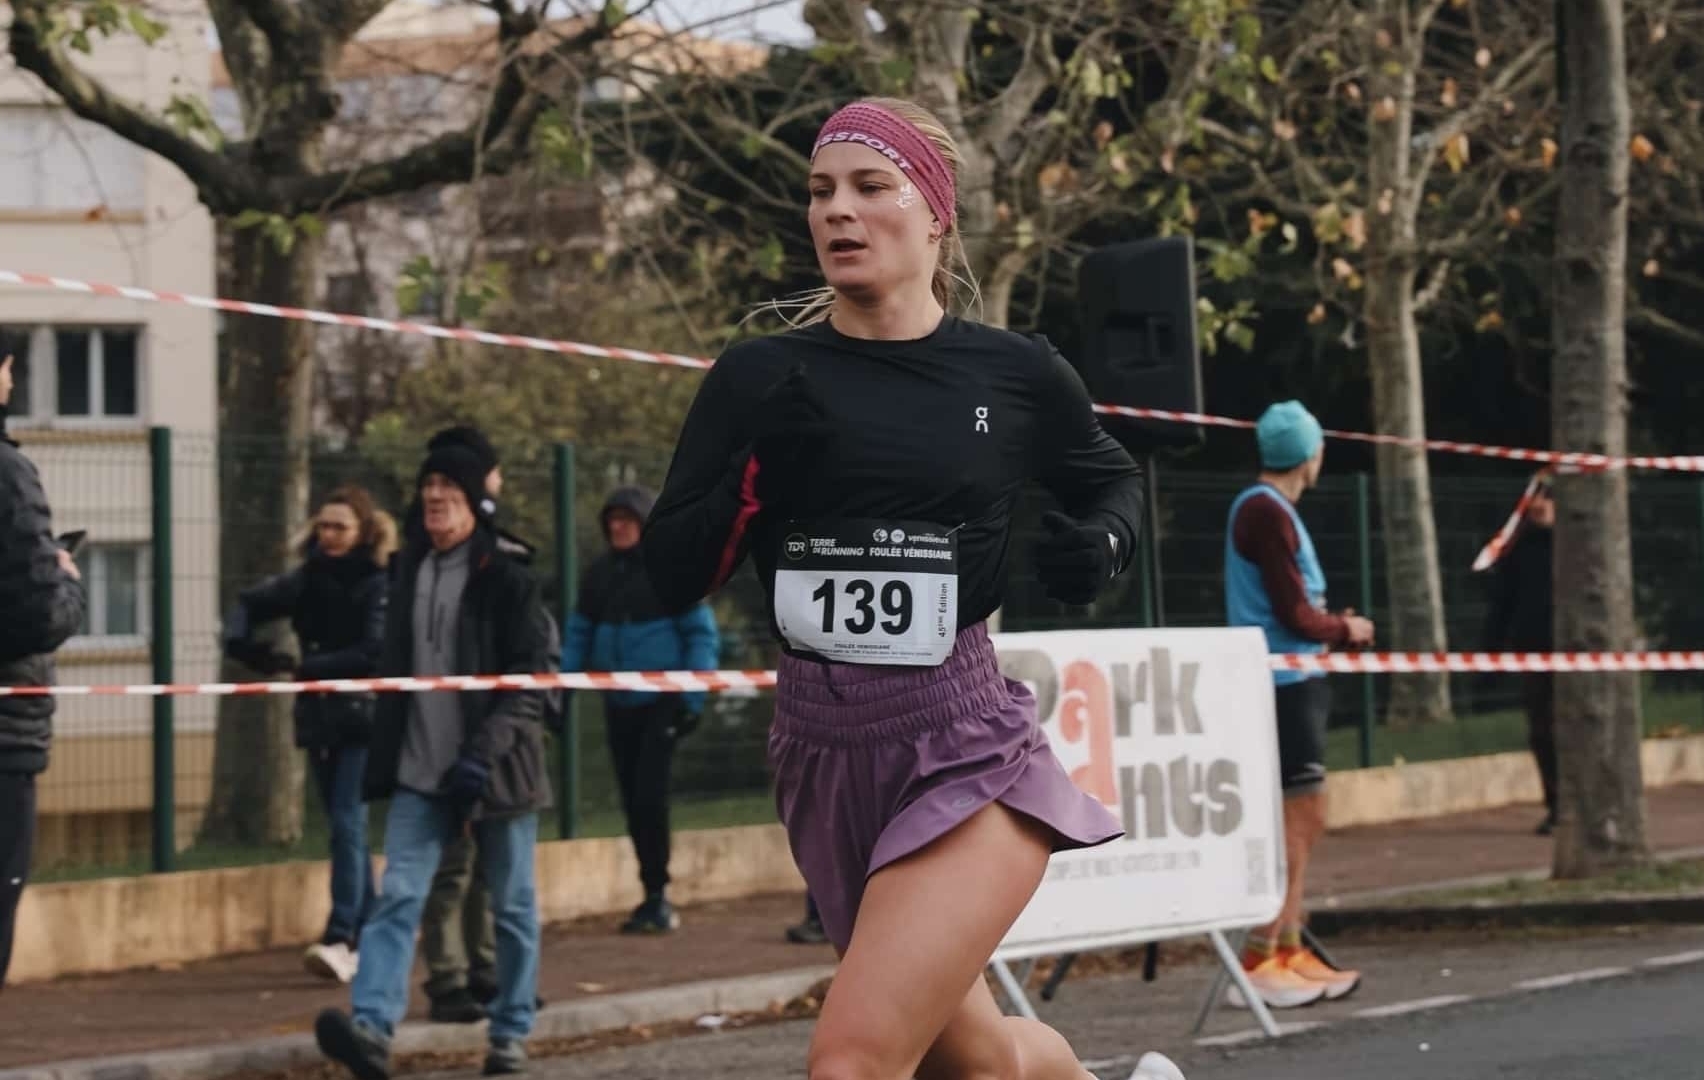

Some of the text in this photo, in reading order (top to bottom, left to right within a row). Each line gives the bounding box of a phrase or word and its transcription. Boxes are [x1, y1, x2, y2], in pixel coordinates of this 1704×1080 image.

[787, 541, 806, 552] TDR
[809, 538, 837, 547] TERRE
[821, 547, 865, 556] RUNNING
[812, 578, 913, 635] 139
